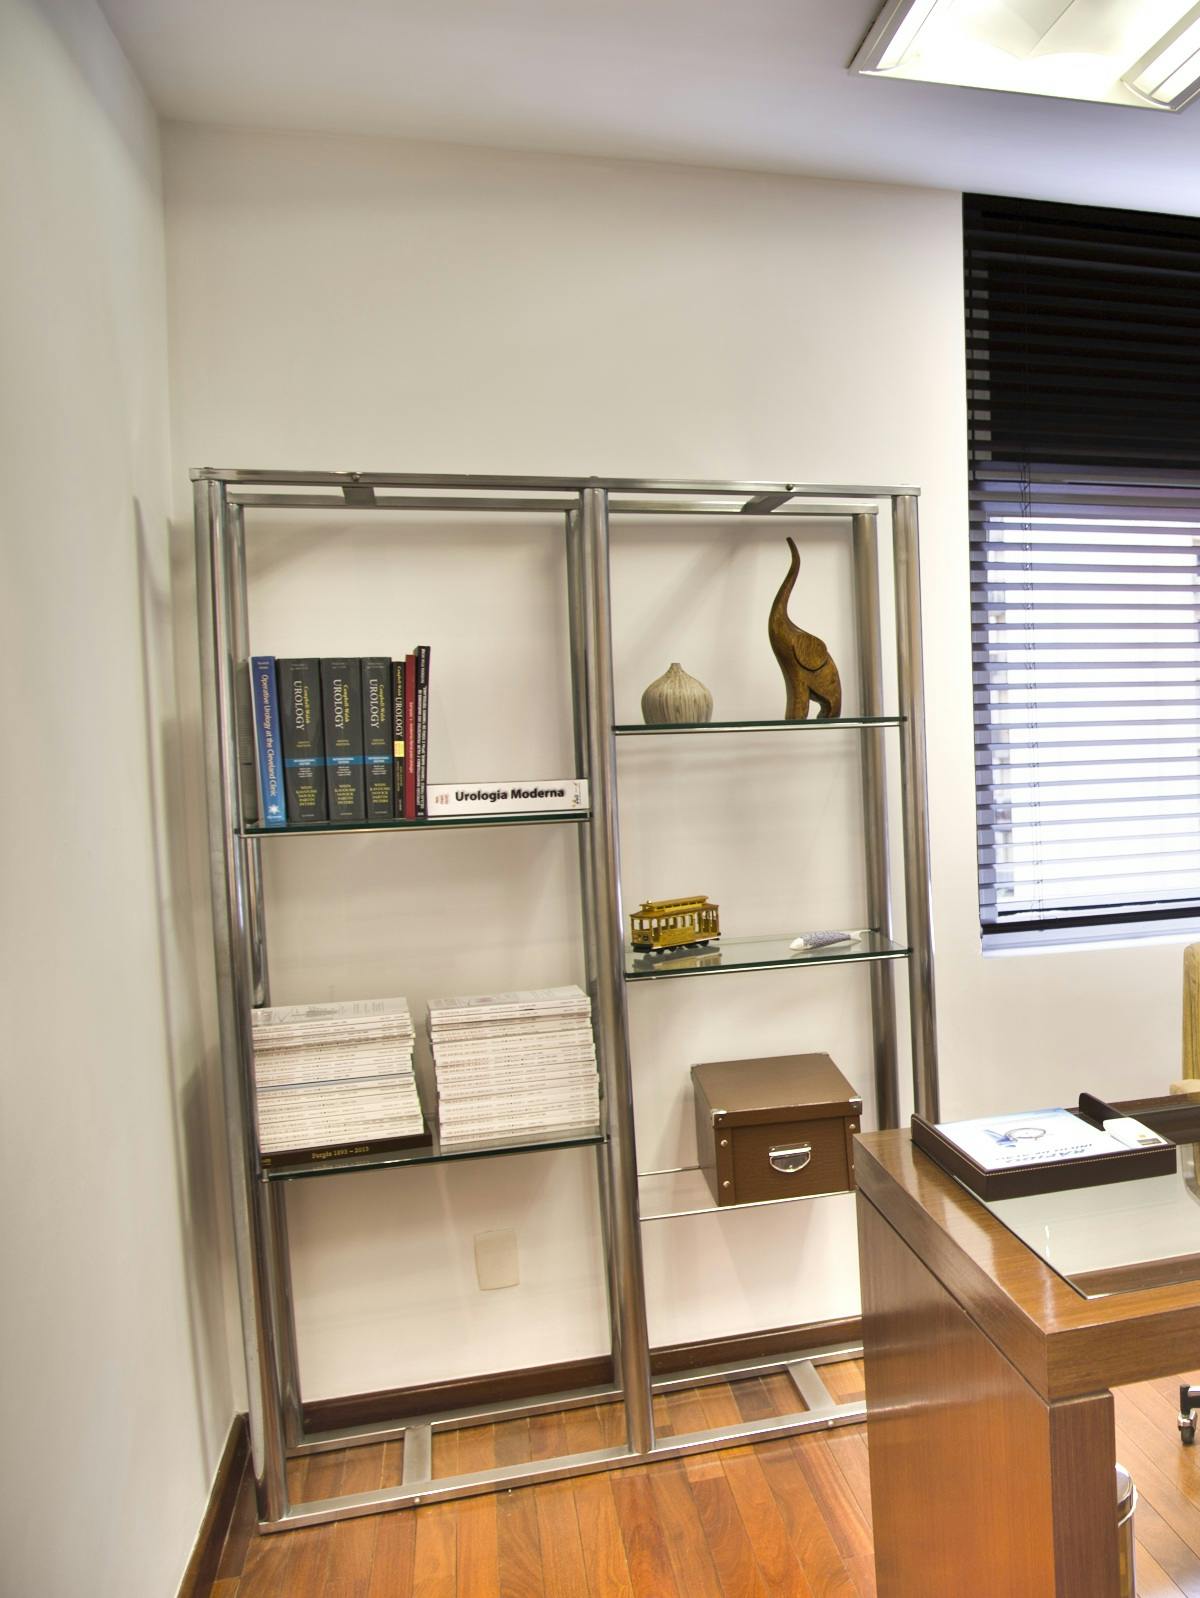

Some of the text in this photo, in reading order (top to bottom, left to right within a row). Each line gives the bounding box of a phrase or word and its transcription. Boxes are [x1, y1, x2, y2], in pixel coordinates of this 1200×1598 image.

[261, 674, 270, 705] Operative
[333, 679, 344, 729] UROLOGY
[369, 679, 380, 728] UROLOGY
[263, 705, 272, 729] Urology
[293, 680, 305, 730] UROLOGY
[395, 697, 403, 737] UROLOGY
[265, 730, 273, 738] at
[266, 738, 274, 748] the
[267, 749, 276, 779] Cleveland
[269, 780, 277, 797] Clinic
[455, 790, 508, 803] Urologia
[511, 788, 564, 800] Moderna
